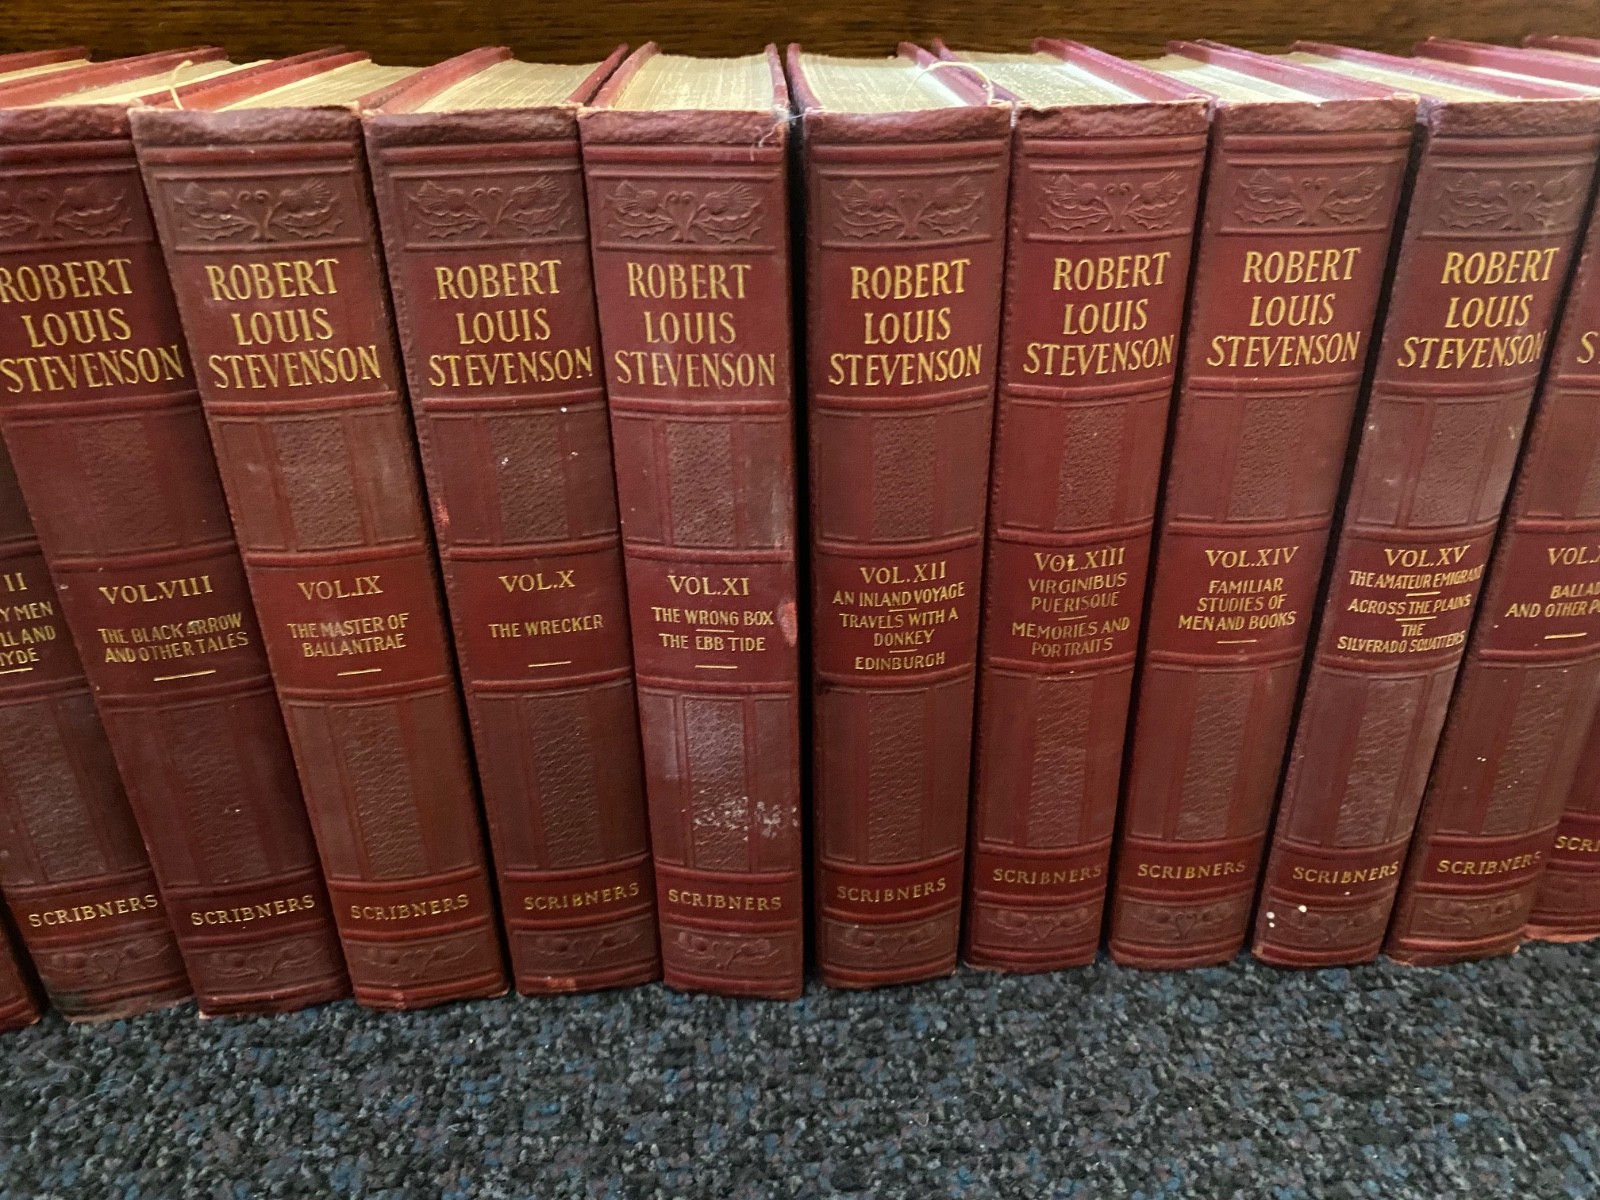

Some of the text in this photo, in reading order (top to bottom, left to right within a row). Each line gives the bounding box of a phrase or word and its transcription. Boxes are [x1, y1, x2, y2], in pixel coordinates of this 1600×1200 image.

[850, 258, 971, 299] ROBERT
[1052, 251, 1171, 292] ROBERT
[1242, 247, 1361, 284] ROBERT
[1441, 247, 1560, 286] ROBERT
[0, 258, 133, 303] ROBERT
[204, 258, 340, 301] ROBERT
[434, 260, 563, 300] ROBERT
[627, 262, 752, 300] ROBERT
[1063, 298, 1149, 336] LOUIS
[1249, 293, 1336, 328] LOUIS
[1444, 294, 1533, 330] LOUIS
[21, 307, 132, 348] LOUIS
[231, 307, 333, 346] LOUIS
[456, 308, 552, 346] LOUIS
[643, 311, 737, 345] LOUIS
[863, 307, 952, 345] LOUIS
[1023, 334, 1175, 377] STEVENSON
[1207, 331, 1361, 368] STEVENSON
[1397, 329, 1547, 370] STEVENSON
[0, 345, 186, 393] STEVENSON
[208, 345, 383, 390] STEVENSON
[428, 346, 593, 387] STEVENSON
[613, 350, 776, 388] STEVENSON
[828, 343, 982, 386] STEVENSON
[1028, 572, 1128, 595] VIRGINIBUS
[1208, 577, 1284, 594] FAMILIAR
[1349, 570, 1375, 588] THE
[1376, 571, 1431, 590] AMATEUR
[832, 581, 966, 607] AN INLAND VOYAGE
[1031, 591, 1120, 612] PUERISQUE
[1196, 593, 1288, 613] STUDIES OF
[1347, 593, 1472, 615] ACROSS THE PLAINS
[13, 601, 54, 620] MEN
[651, 606, 775, 626] THE WRONG BOX
[838, 607, 959, 629] TRAVELS WITH A
[1178, 611, 1297, 631] MEN AND BOOKS
[1504, 603, 1541, 618] AND
[1544, 601, 1588, 618] OTHER
[21, 625, 56, 645] AND
[97, 612, 243, 644] THE BLACK ARROW
[287, 613, 410, 639] THE MASTER OF
[488, 614, 604, 638] THE WRECKER
[873, 628, 935, 647] DONKEY
[1012, 616, 1131, 641] MEMORIES AND
[1400, 623, 1426, 637] THE
[104, 631, 249, 663] AND OTHER TALES
[302, 634, 407, 658] BALLANTRAE
[658, 633, 766, 652] THE EBB TIDE
[1031, 637, 1114, 657] PORTRAITS
[1337, 630, 1466, 653] SILVERADO SQUATTERS
[854, 651, 946, 671] EDINBURGH
[993, 864, 1102, 886] SCRIBNERS
[1138, 859, 1246, 880] SCRIBNERS
[1293, 860, 1399, 885] SCRIBNERS
[1437, 850, 1541, 875] SCRIBNERS
[523, 882, 640, 911] SCRIBNERS
[668, 888, 782, 911] SCRIBNERS
[836, 877, 947, 904] SCRIBNERS
[28, 894, 159, 928] SCRIBNERS
[190, 894, 316, 927] SCRIBNERS
[350, 894, 469, 921] SCRIBNERS
